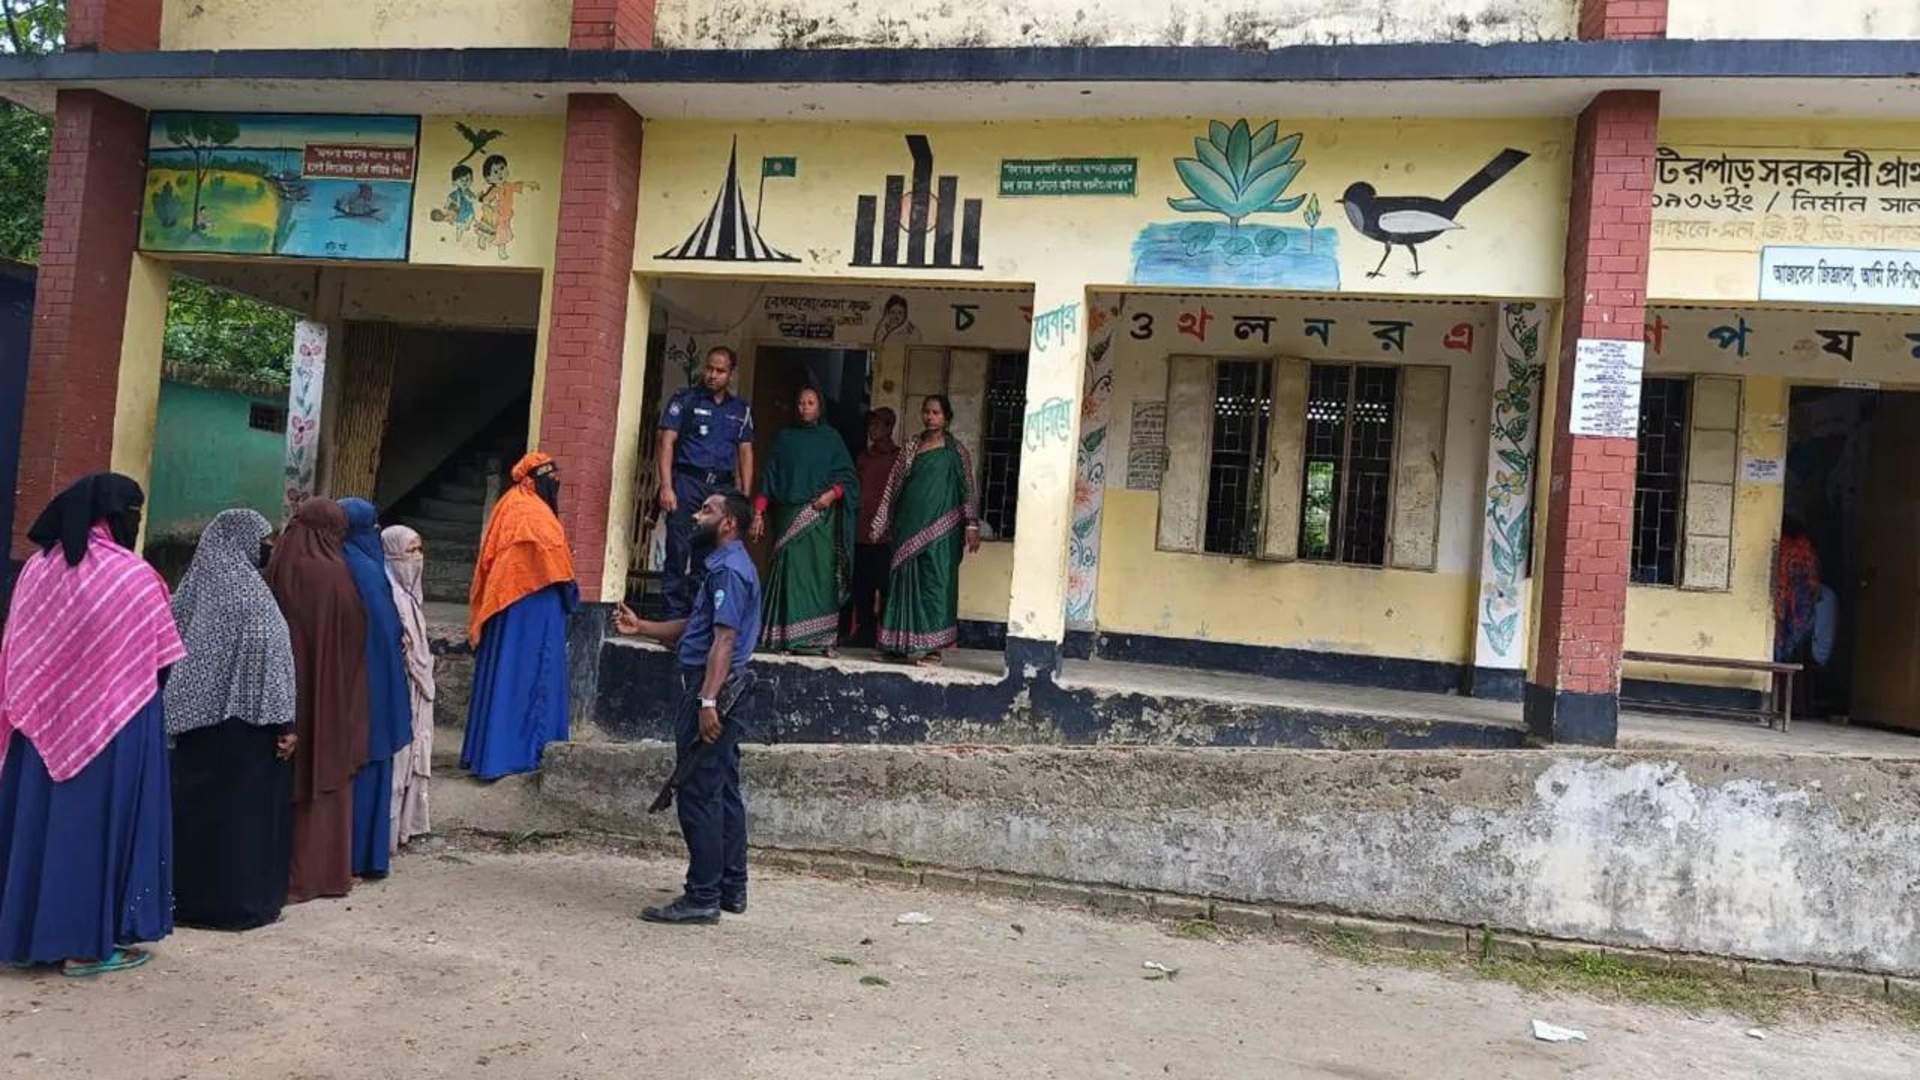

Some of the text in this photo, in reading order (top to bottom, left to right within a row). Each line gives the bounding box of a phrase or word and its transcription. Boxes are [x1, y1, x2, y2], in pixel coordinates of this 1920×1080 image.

[1758, 149, 1872, 188] সরকারী
[1791, 188, 1868, 213] নির্মান
[1233, 316, 1276, 344] ল
[1303, 318, 1336, 347] ন
[1368, 320, 1413, 352] র
